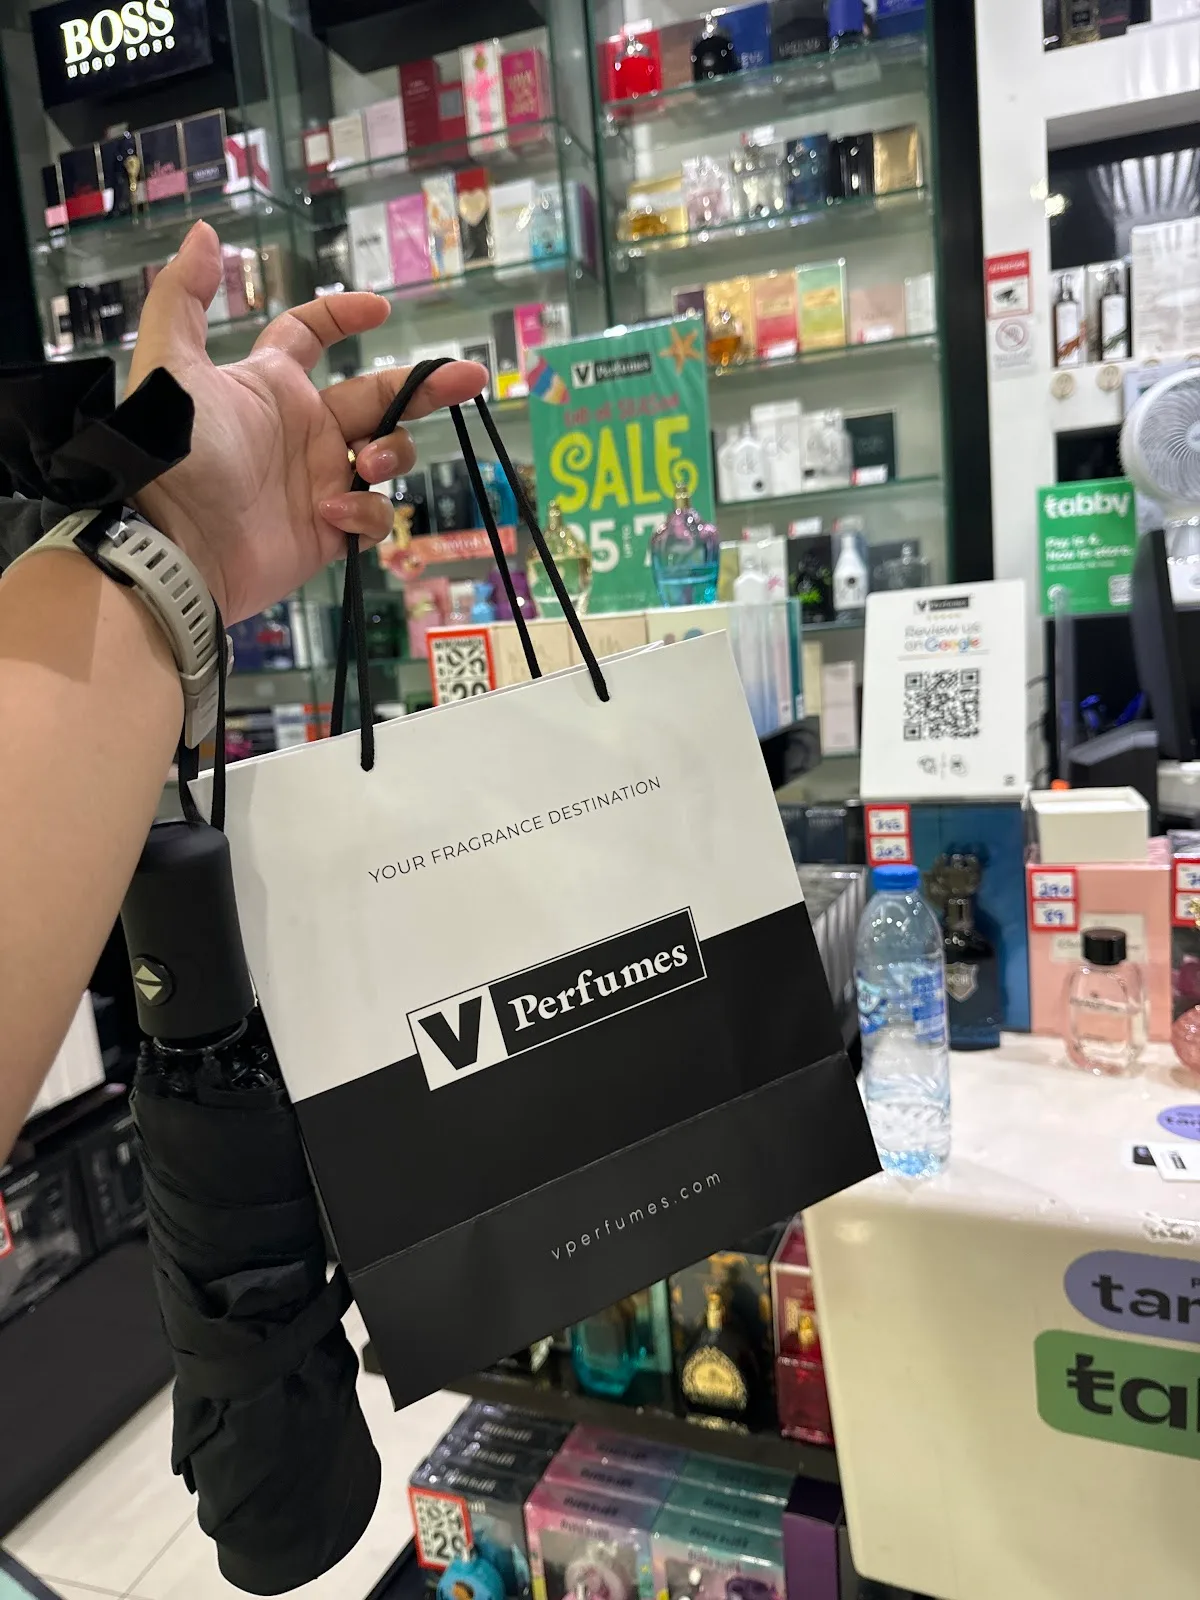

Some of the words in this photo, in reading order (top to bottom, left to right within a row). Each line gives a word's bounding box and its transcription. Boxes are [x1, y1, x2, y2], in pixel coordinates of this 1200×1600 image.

[60, 0, 174, 64] BOSS
[67, 53, 116, 79] HUGO
[126, 35, 175, 61] BOSS
[575, 364, 593, 384] V
[551, 415, 698, 513] SALE
[1044, 491, 1131, 519] tabby
[904, 624, 959, 638] Review
[904, 640, 924, 651] on
[925, 637, 981, 654] Google
[368, 854, 426, 883] YOUR
[431, 816, 544, 864] FRAGRANCE
[548, 776, 661, 825] DESTINATION
[417, 995, 483, 1071] V
[508, 944, 689, 1031] Perfumes
[551, 1172, 721, 1259] vperfumes.com
